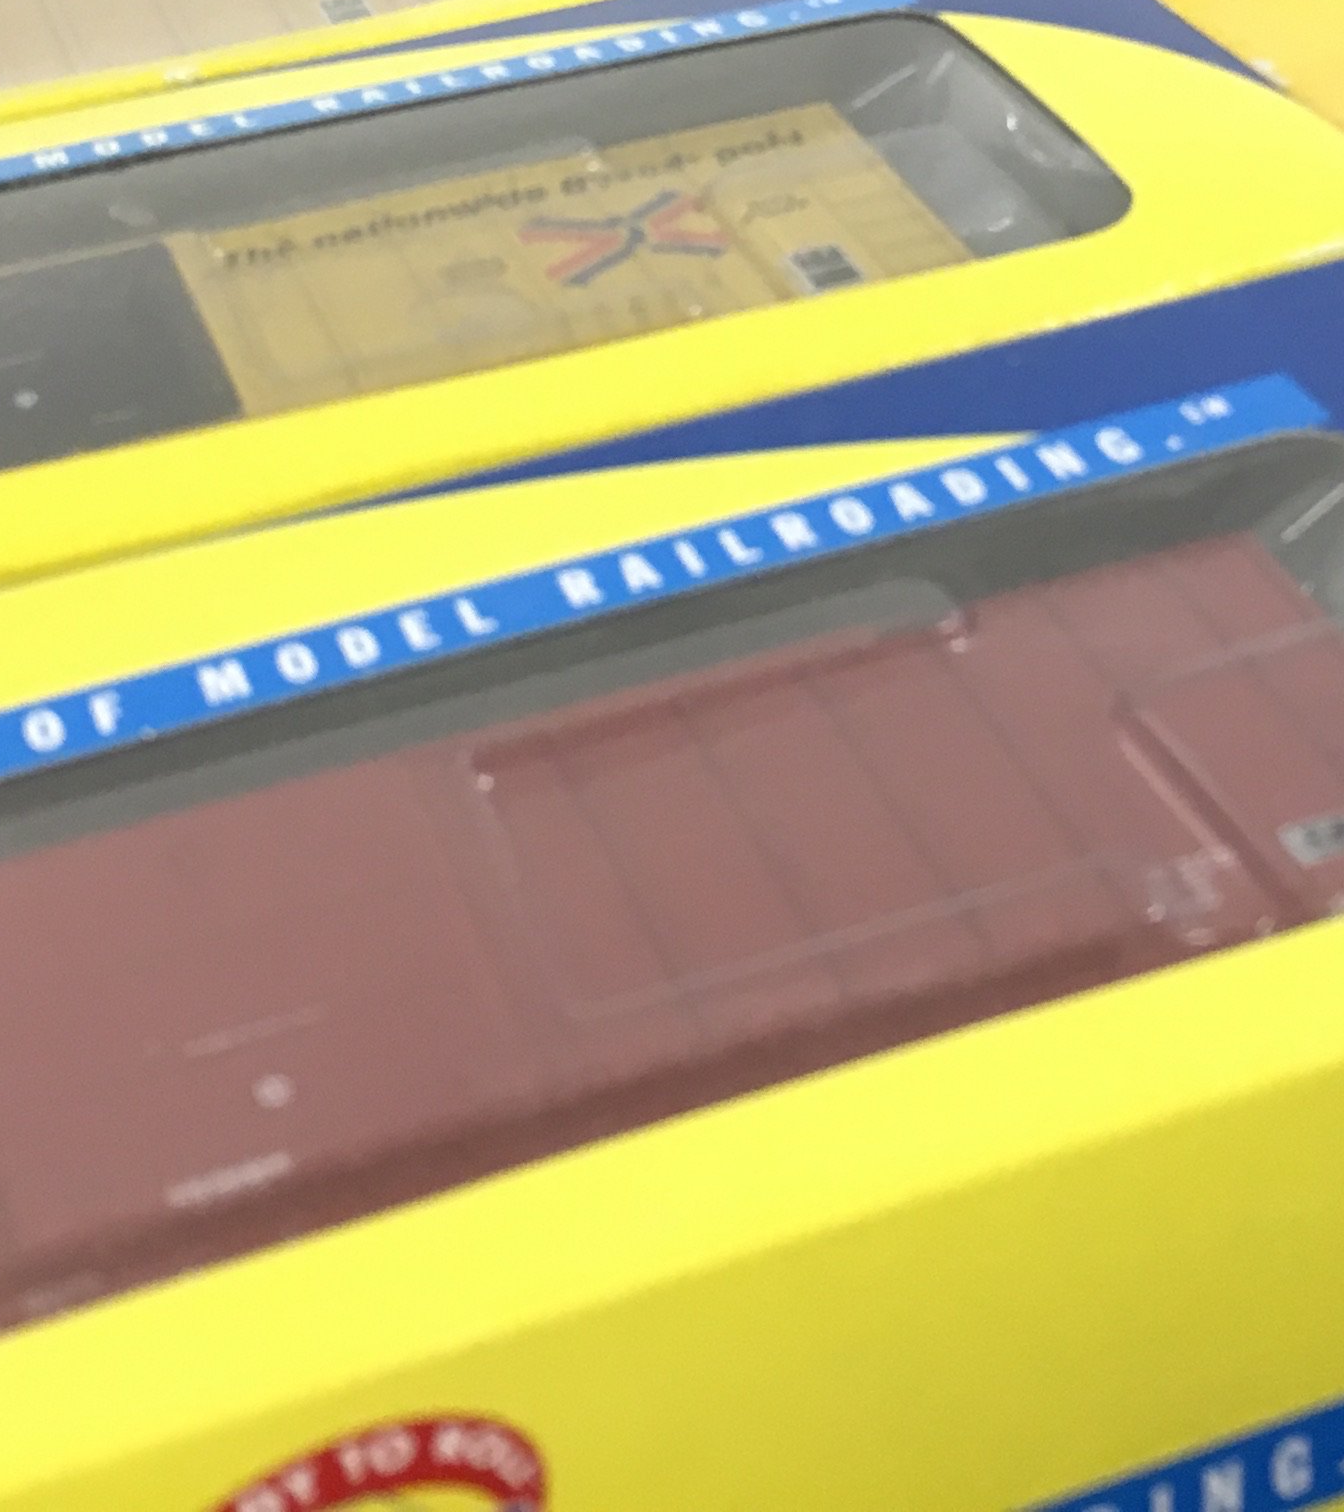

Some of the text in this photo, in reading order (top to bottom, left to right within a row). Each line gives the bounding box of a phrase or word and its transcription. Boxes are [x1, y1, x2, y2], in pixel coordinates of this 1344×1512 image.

[33, 109, 254, 173] MODEL
[20, 692, 128, 756] OF
[193, 597, 501, 709] MODEL
